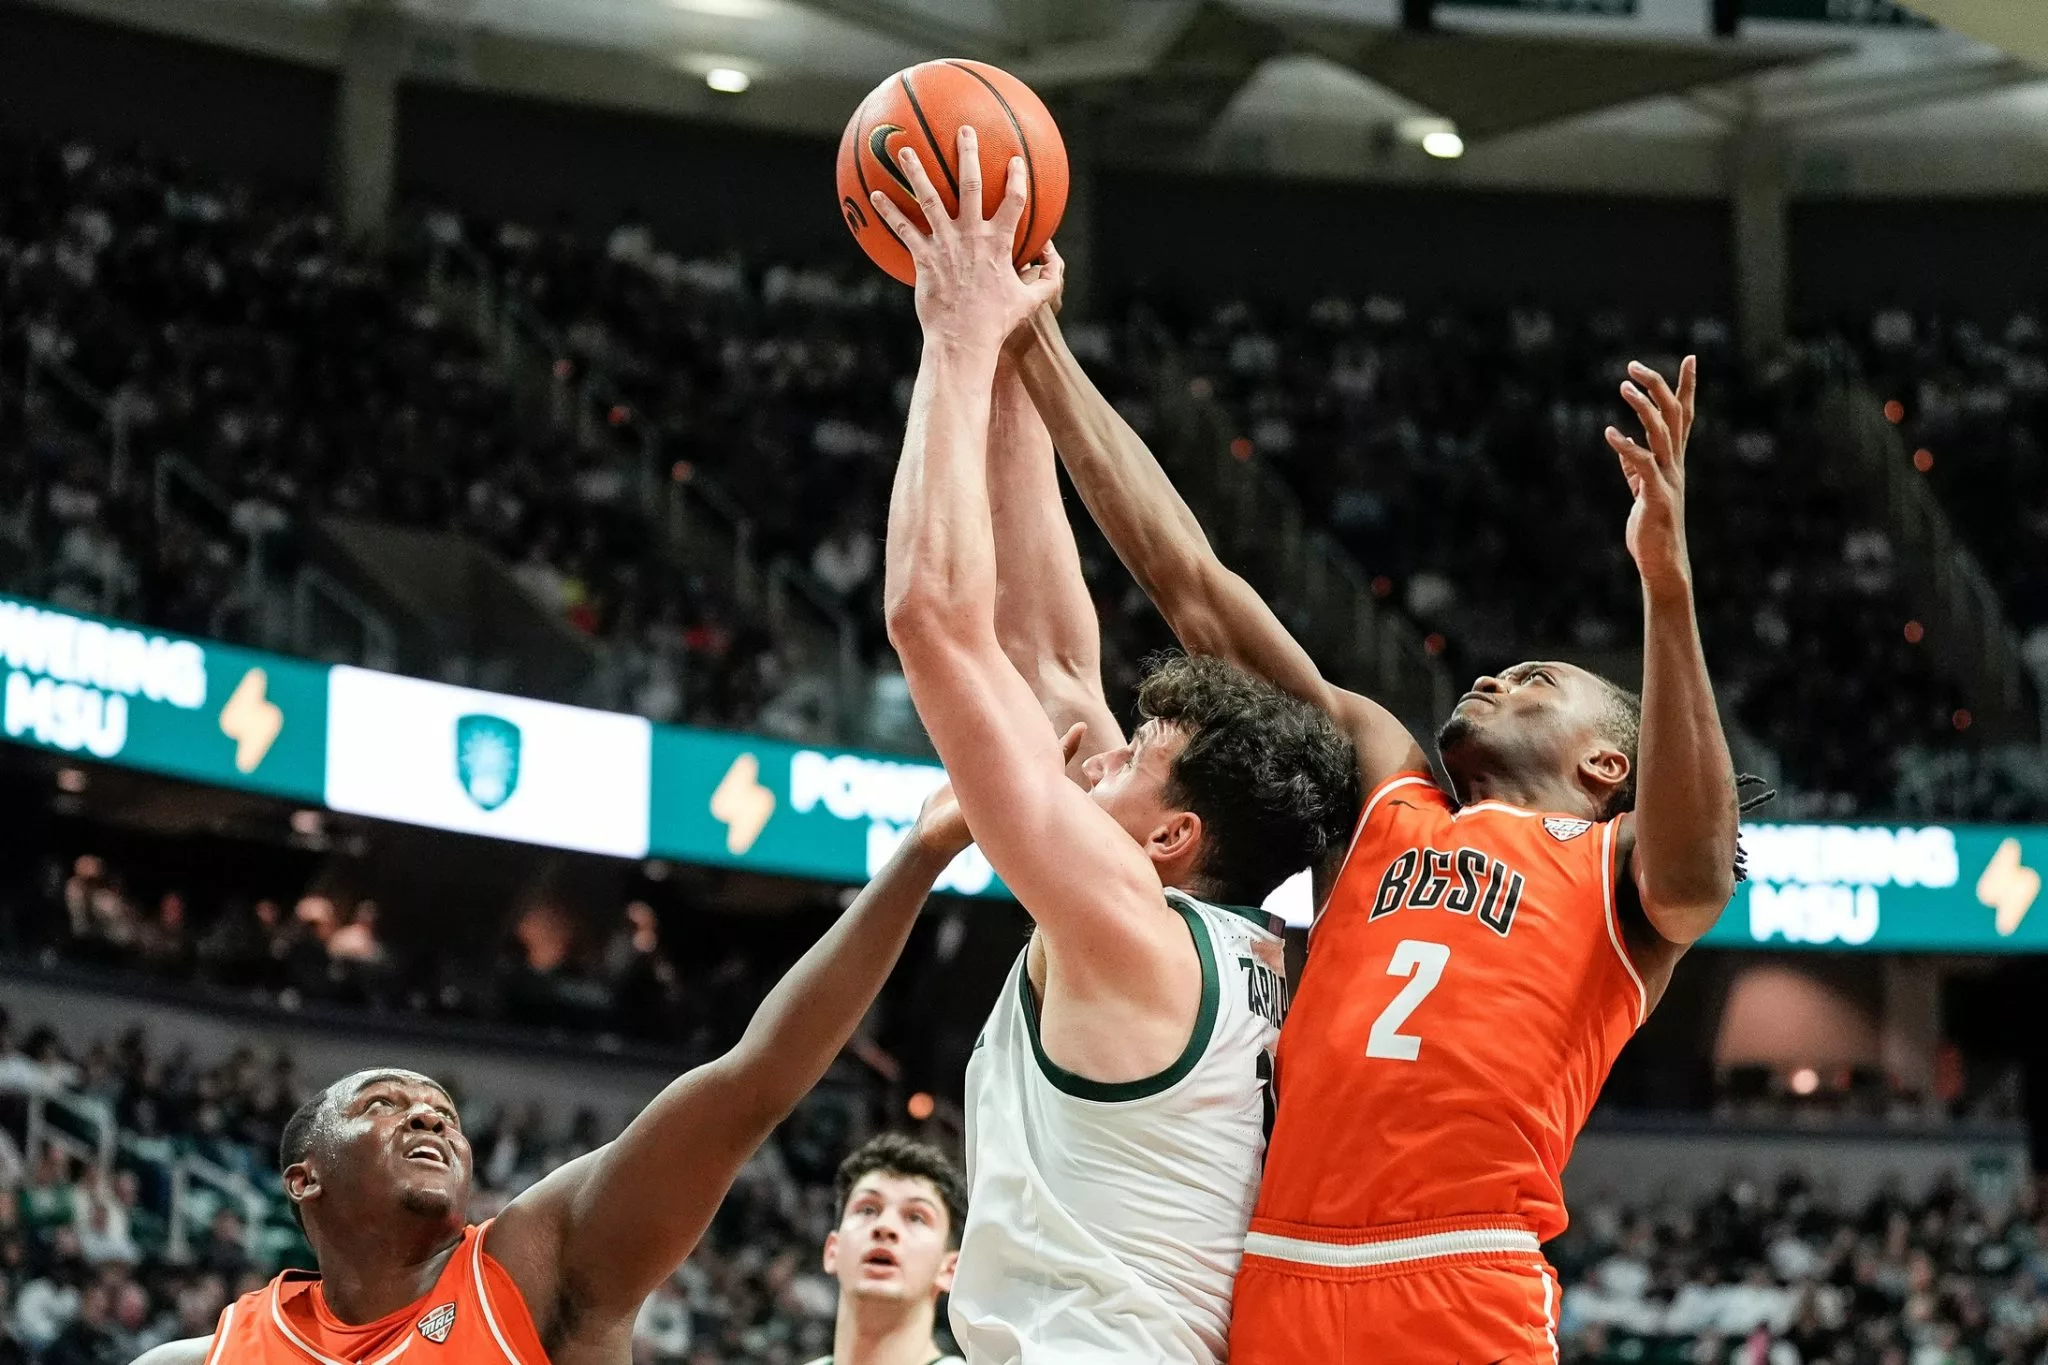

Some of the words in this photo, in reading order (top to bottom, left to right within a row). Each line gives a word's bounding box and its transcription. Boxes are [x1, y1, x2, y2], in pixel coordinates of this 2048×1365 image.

[4, 670, 129, 758] MSU
[1367, 846, 1525, 938] BGSU
[1749, 882, 1880, 945] MSU
[1365, 938, 1451, 1061] 2
[420, 1308, 455, 1337] MAC
